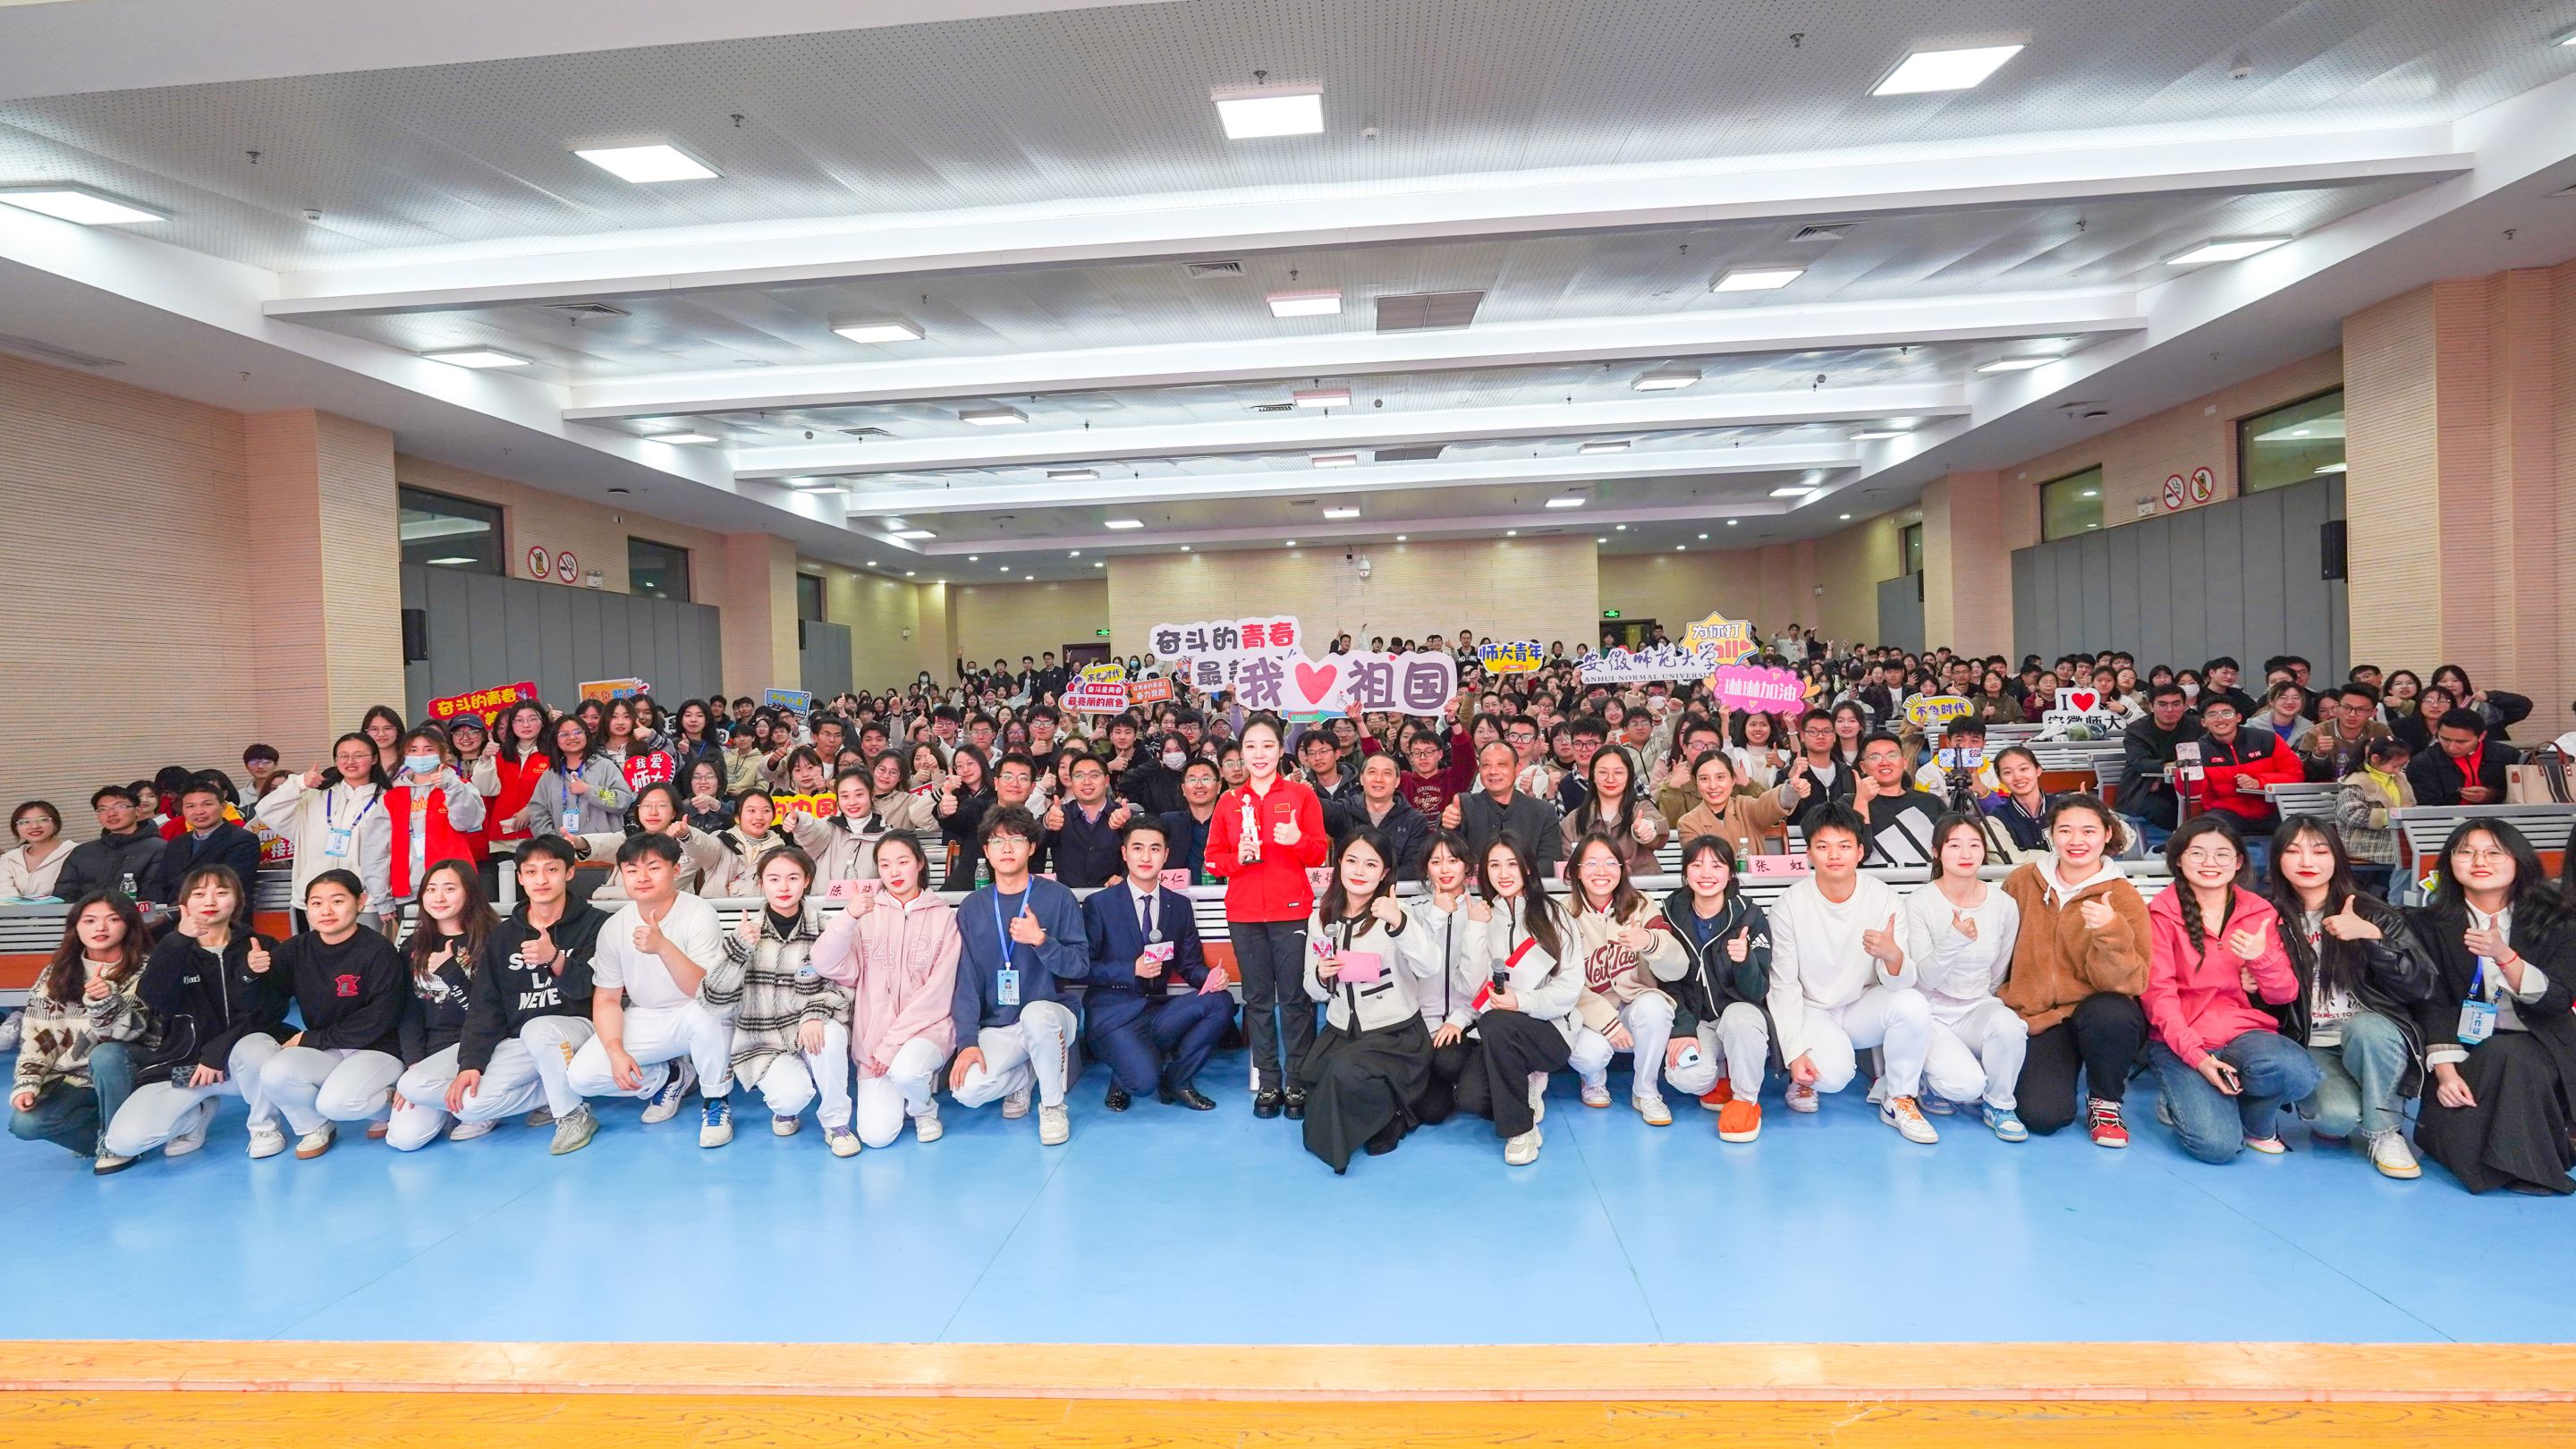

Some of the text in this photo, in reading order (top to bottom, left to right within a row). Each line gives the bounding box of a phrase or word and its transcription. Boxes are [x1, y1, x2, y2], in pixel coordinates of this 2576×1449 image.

[1156, 621, 1295, 655] 奋斗的青春
[1692, 623, 1741, 640] 为你打
[1479, 642, 1543, 662] 师大青年
[1579, 642, 1716, 672] 安徽师范大学
[1238, 657, 1449, 710] 我 祖国
[1724, 678, 1797, 702] 琳琳加油
[436, 687, 517, 716] 奋斗的青春
[1067, 696, 1124, 708] 最亮丽的底色
[1915, 702, 1967, 717] 不负时代
[2060, 693, 2069, 711] I
[636, 753, 664, 769] 我爱
[1755, 860, 1805, 872] 张 虹
